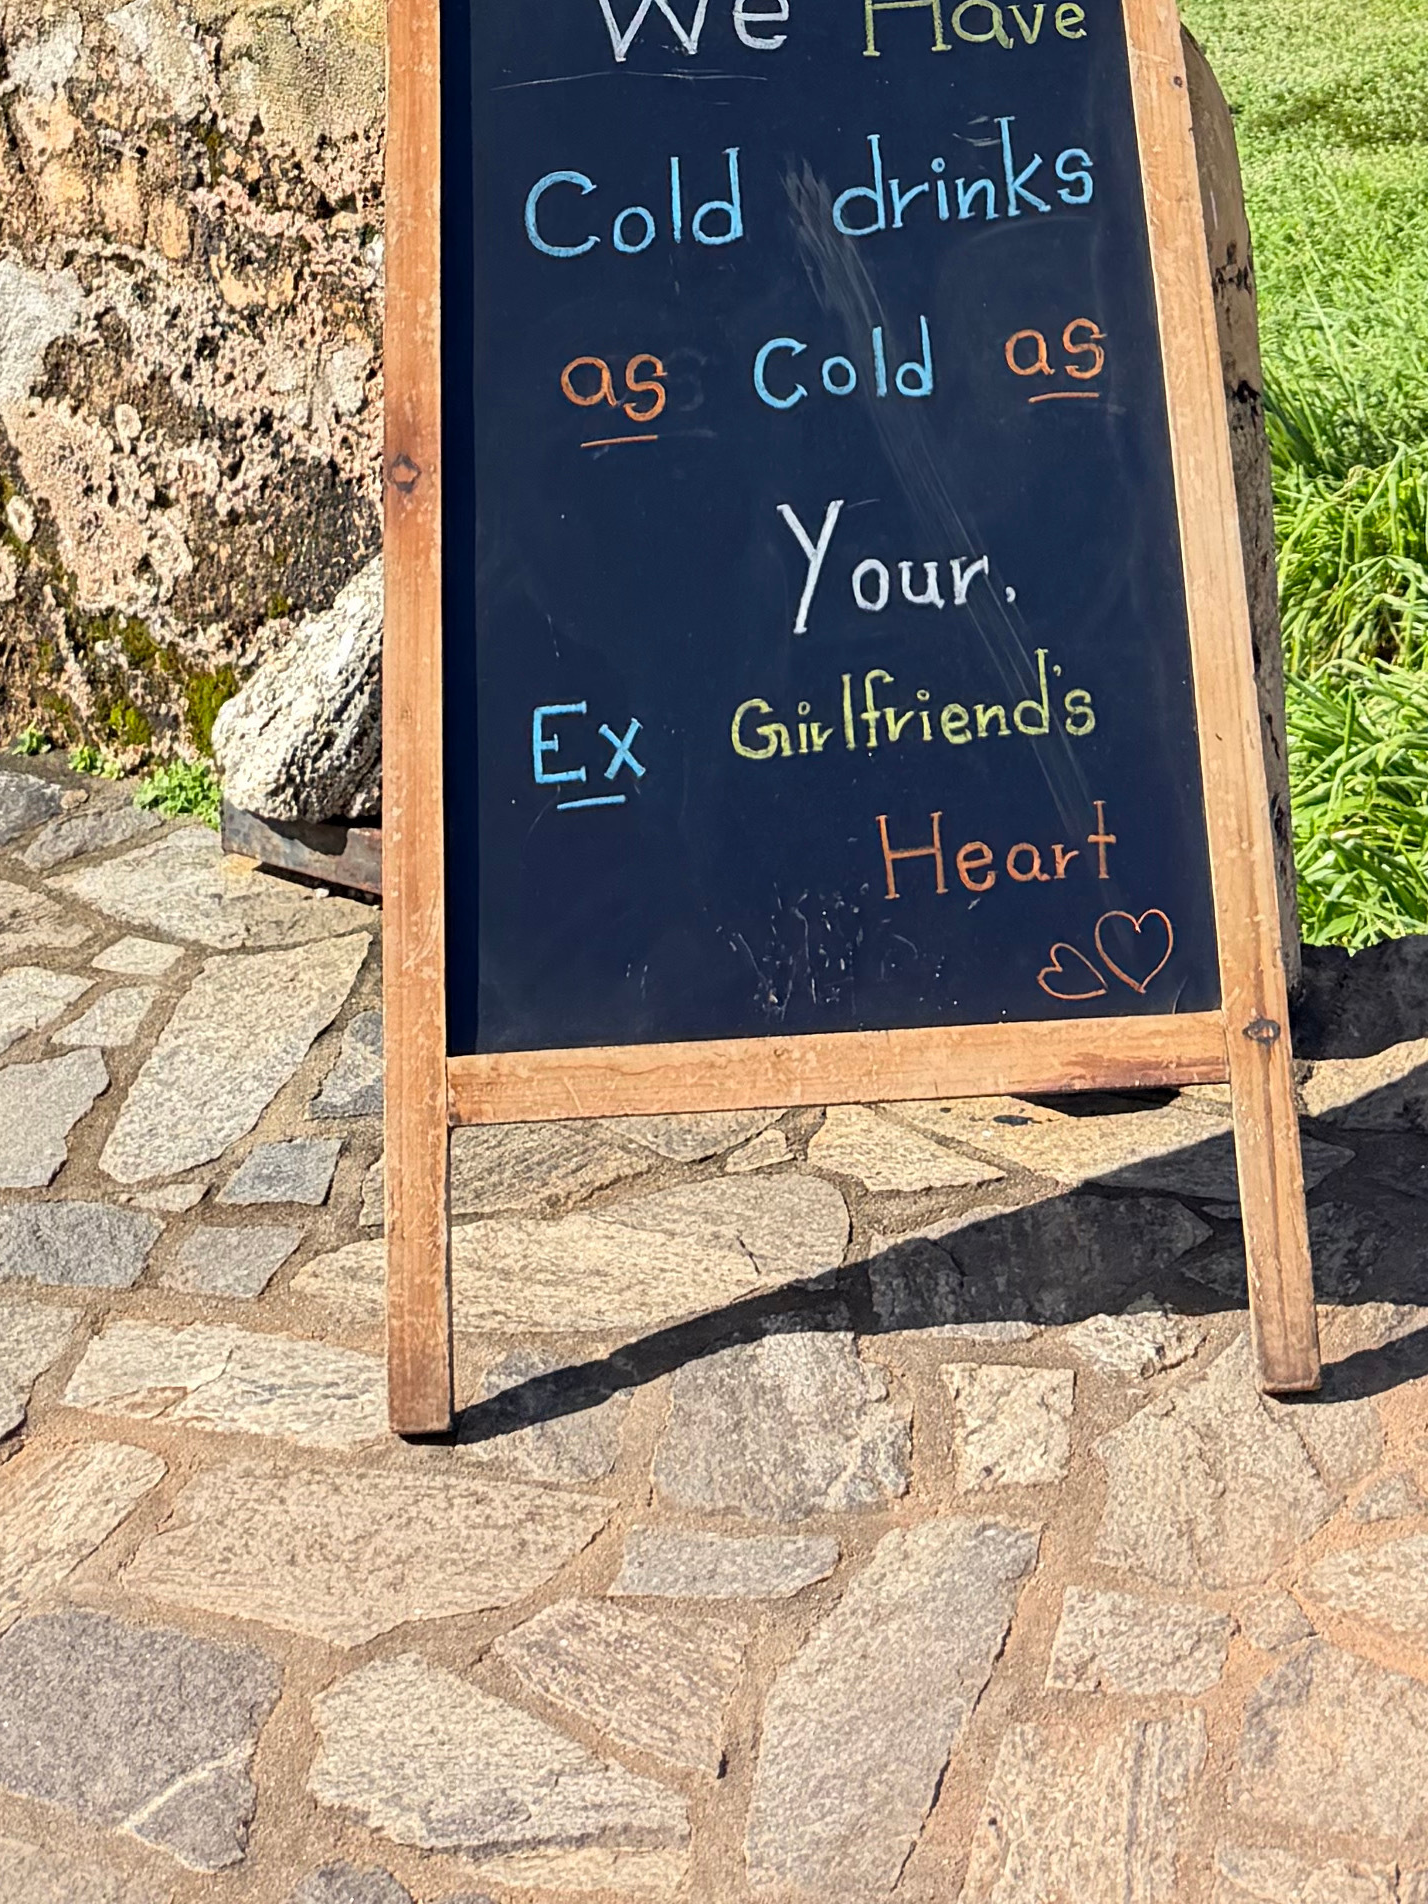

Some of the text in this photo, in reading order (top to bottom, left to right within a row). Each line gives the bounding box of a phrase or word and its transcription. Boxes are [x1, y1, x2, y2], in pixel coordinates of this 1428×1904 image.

[524, 116, 1095, 258] Cold drinks
[560, 315, 1109, 422] as Cold as
[532, 648, 1096, 785] Ex Girlfriend's
[875, 799, 1118, 900] Heart
